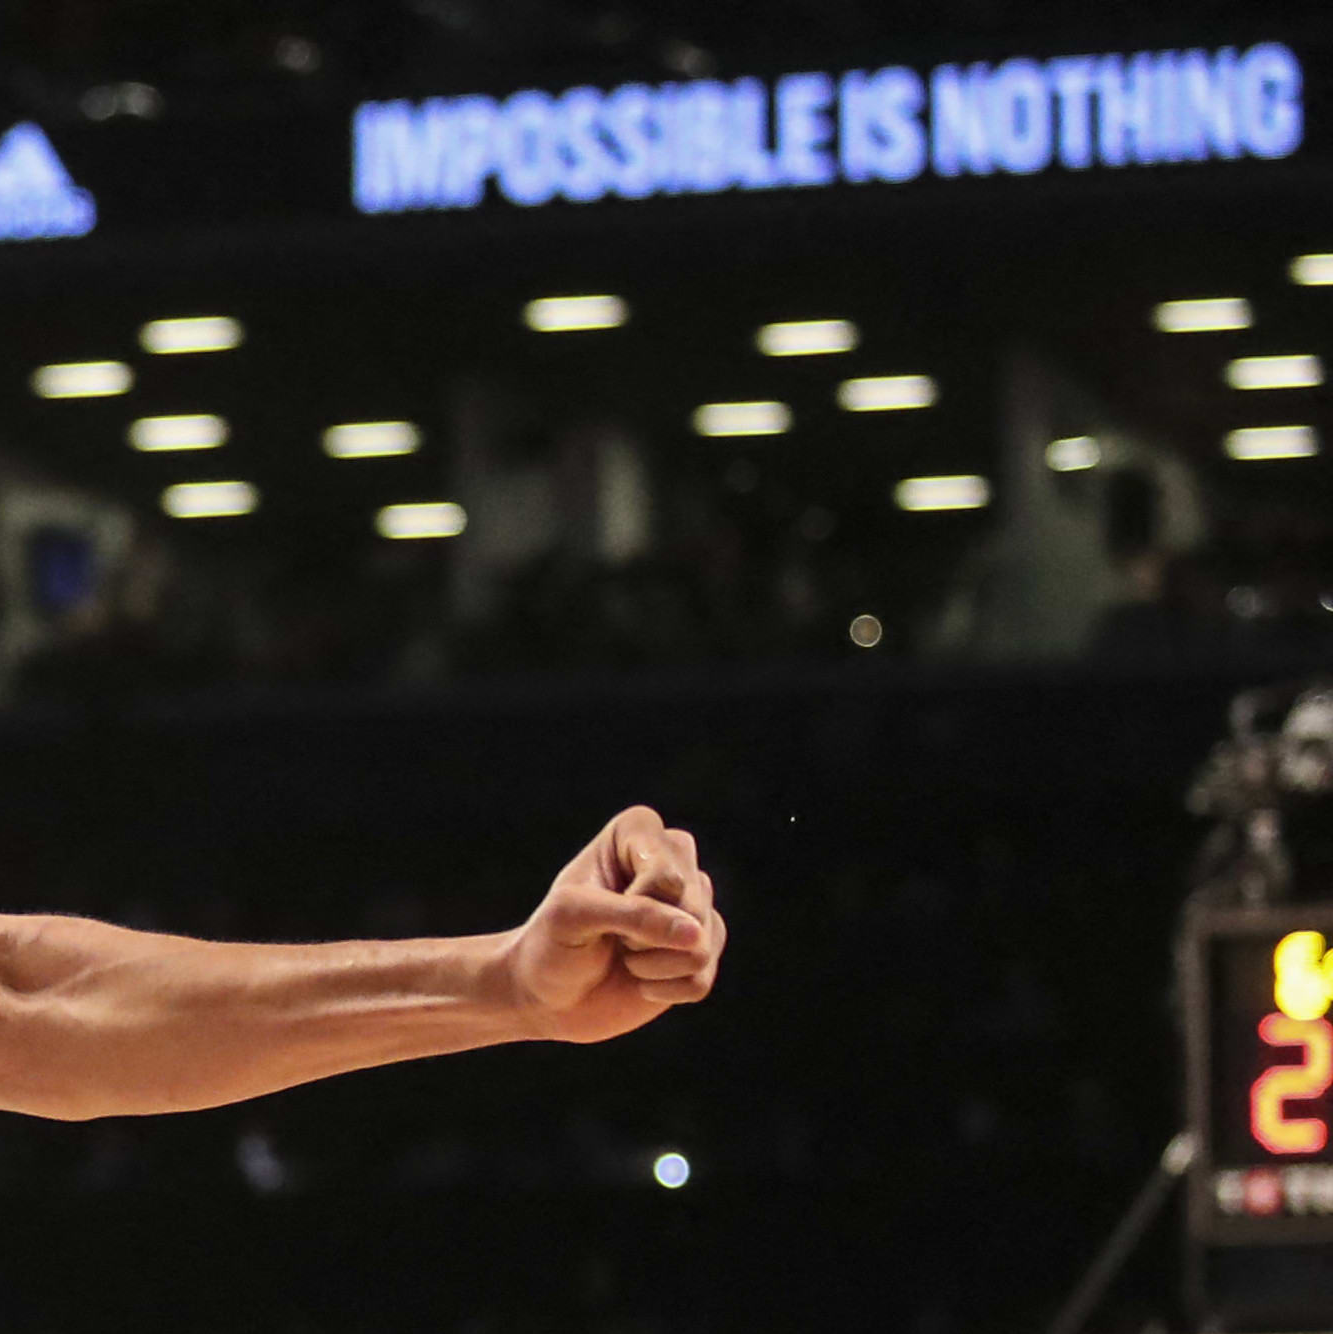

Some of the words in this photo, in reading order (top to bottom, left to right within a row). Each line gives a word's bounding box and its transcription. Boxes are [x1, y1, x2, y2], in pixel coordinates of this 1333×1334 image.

[353, 71, 835, 214] IMPOSSIBLE
[838, 65, 926, 184] IS
[931, 41, 1305, 178] NOTHING
[1250, 1012, 1333, 1154] 2
